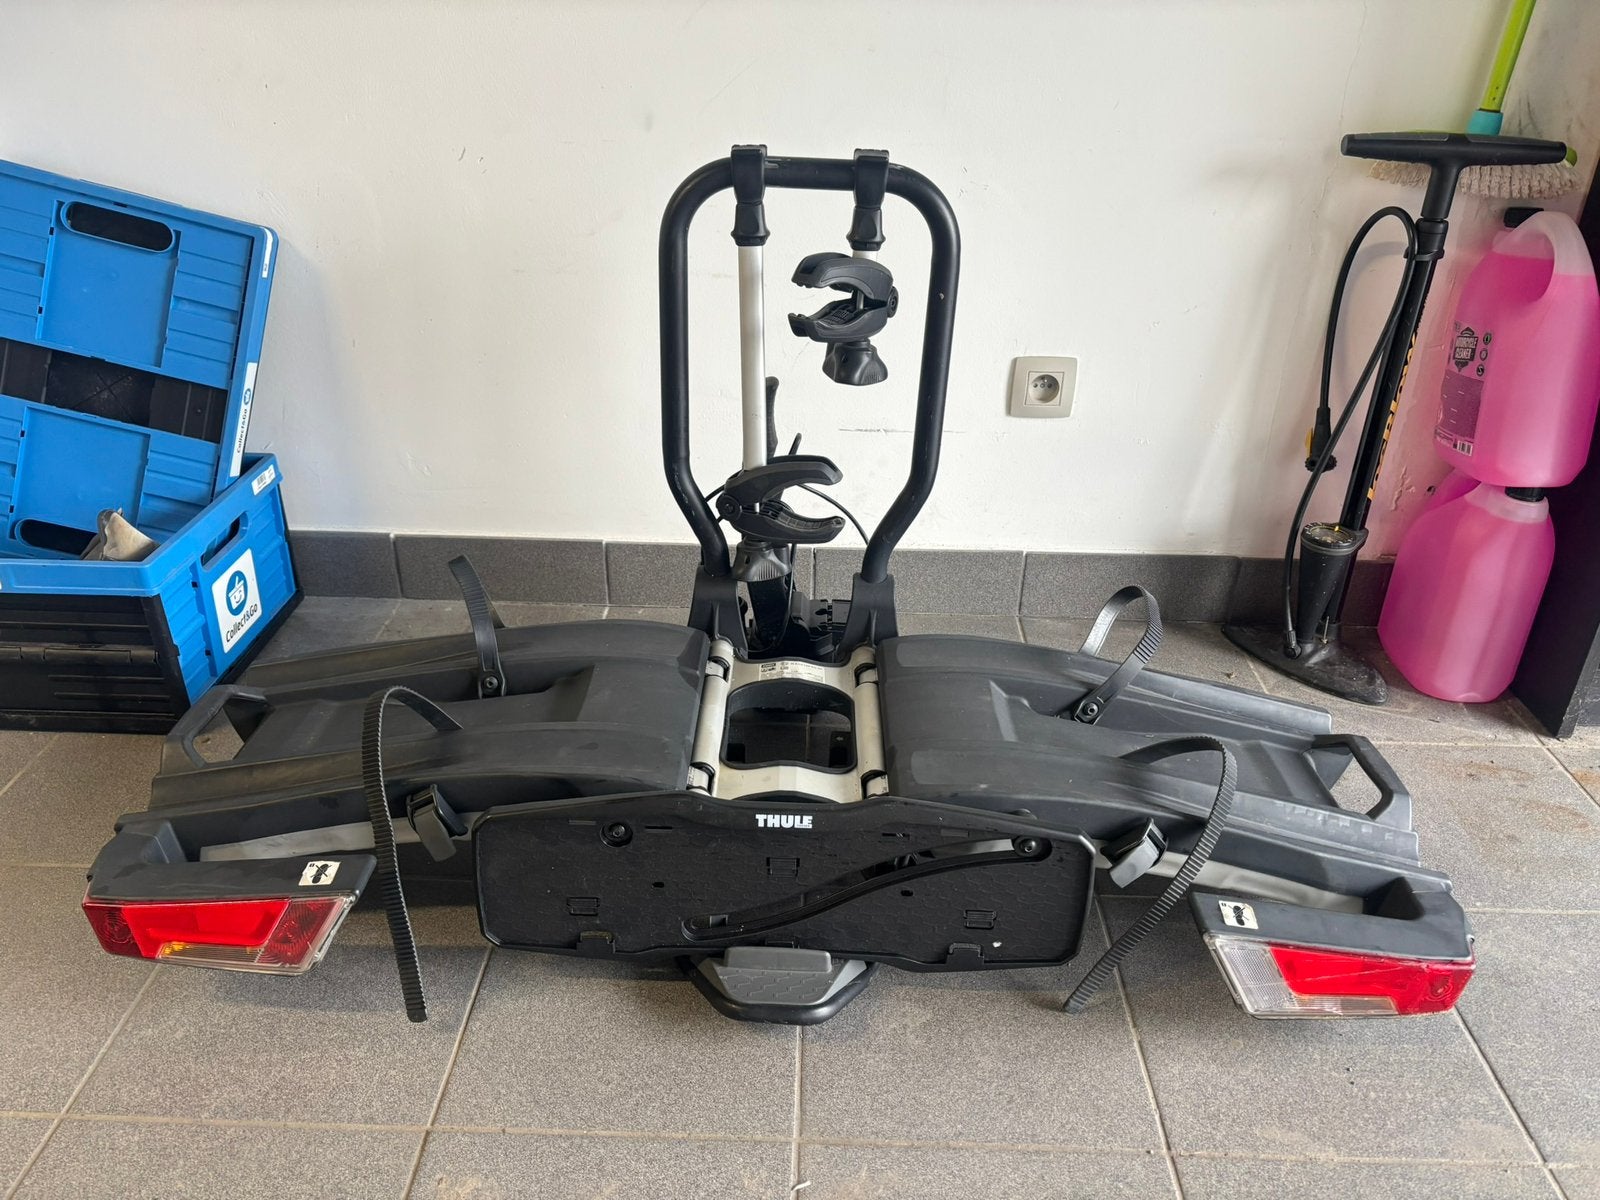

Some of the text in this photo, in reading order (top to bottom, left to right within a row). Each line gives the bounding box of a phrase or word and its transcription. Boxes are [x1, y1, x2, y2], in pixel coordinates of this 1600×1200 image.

[236, 408, 248, 454] Collect&Go
[226, 603, 258, 643] Collect&Go
[755, 814, 813, 829] THULE
